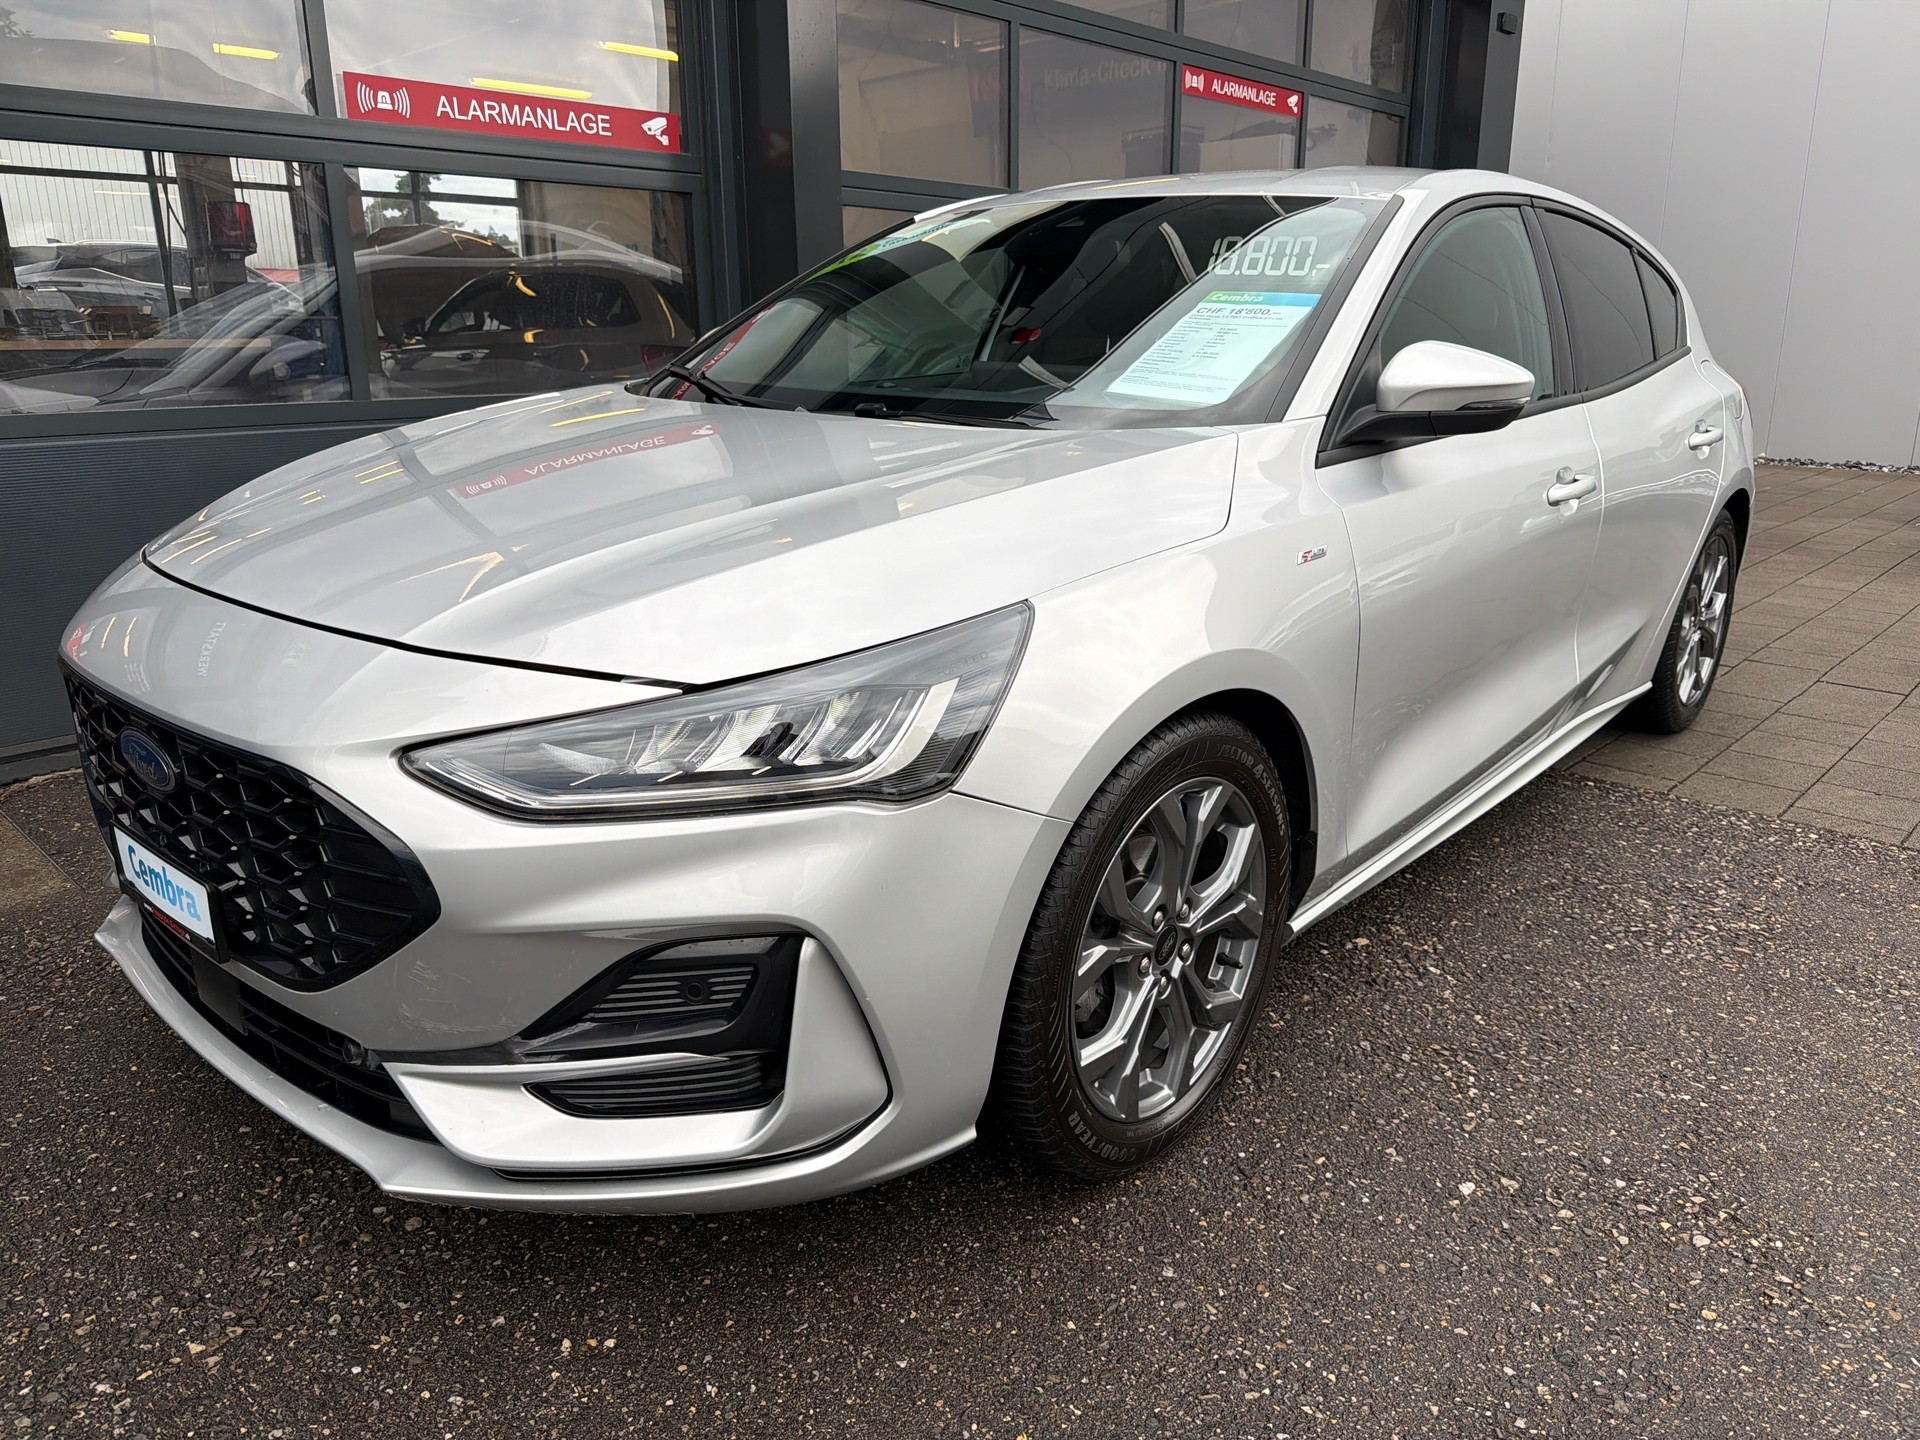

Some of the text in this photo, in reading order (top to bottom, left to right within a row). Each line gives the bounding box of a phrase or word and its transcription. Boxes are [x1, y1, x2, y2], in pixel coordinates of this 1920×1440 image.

[1211, 78, 1277, 107] ALARMANLAGE
[436, 95, 613, 137] ALARMANLAGE
[1196, 307, 1227, 315] CHF
[1211, 293, 1264, 303] Cembra
[129, 742, 158, 780] Ford
[1217, 744, 1254, 769] VECTOR
[127, 844, 202, 922] Cembra
[1068, 1111, 1137, 1161] GOODYEAR
